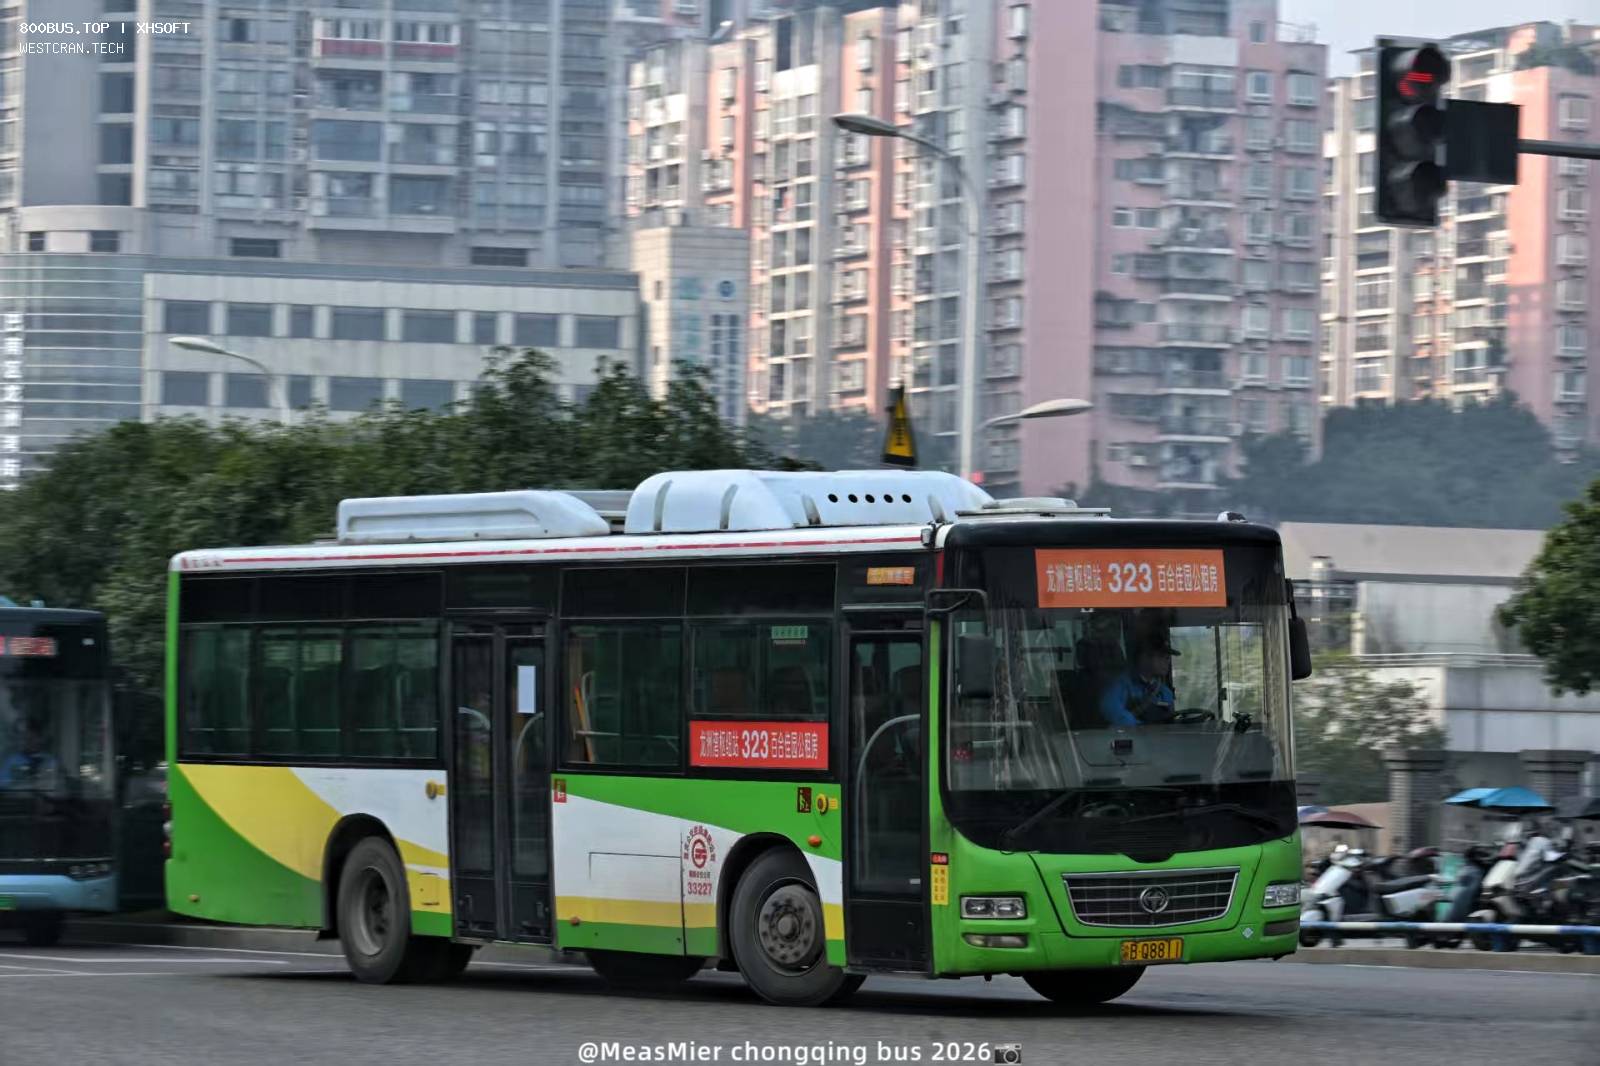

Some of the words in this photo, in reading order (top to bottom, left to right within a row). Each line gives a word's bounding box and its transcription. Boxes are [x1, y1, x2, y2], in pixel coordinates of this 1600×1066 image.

[1108, 563, 1153, 593] 323
[742, 730, 769, 759] 323
[687, 882, 713, 896] 33227
